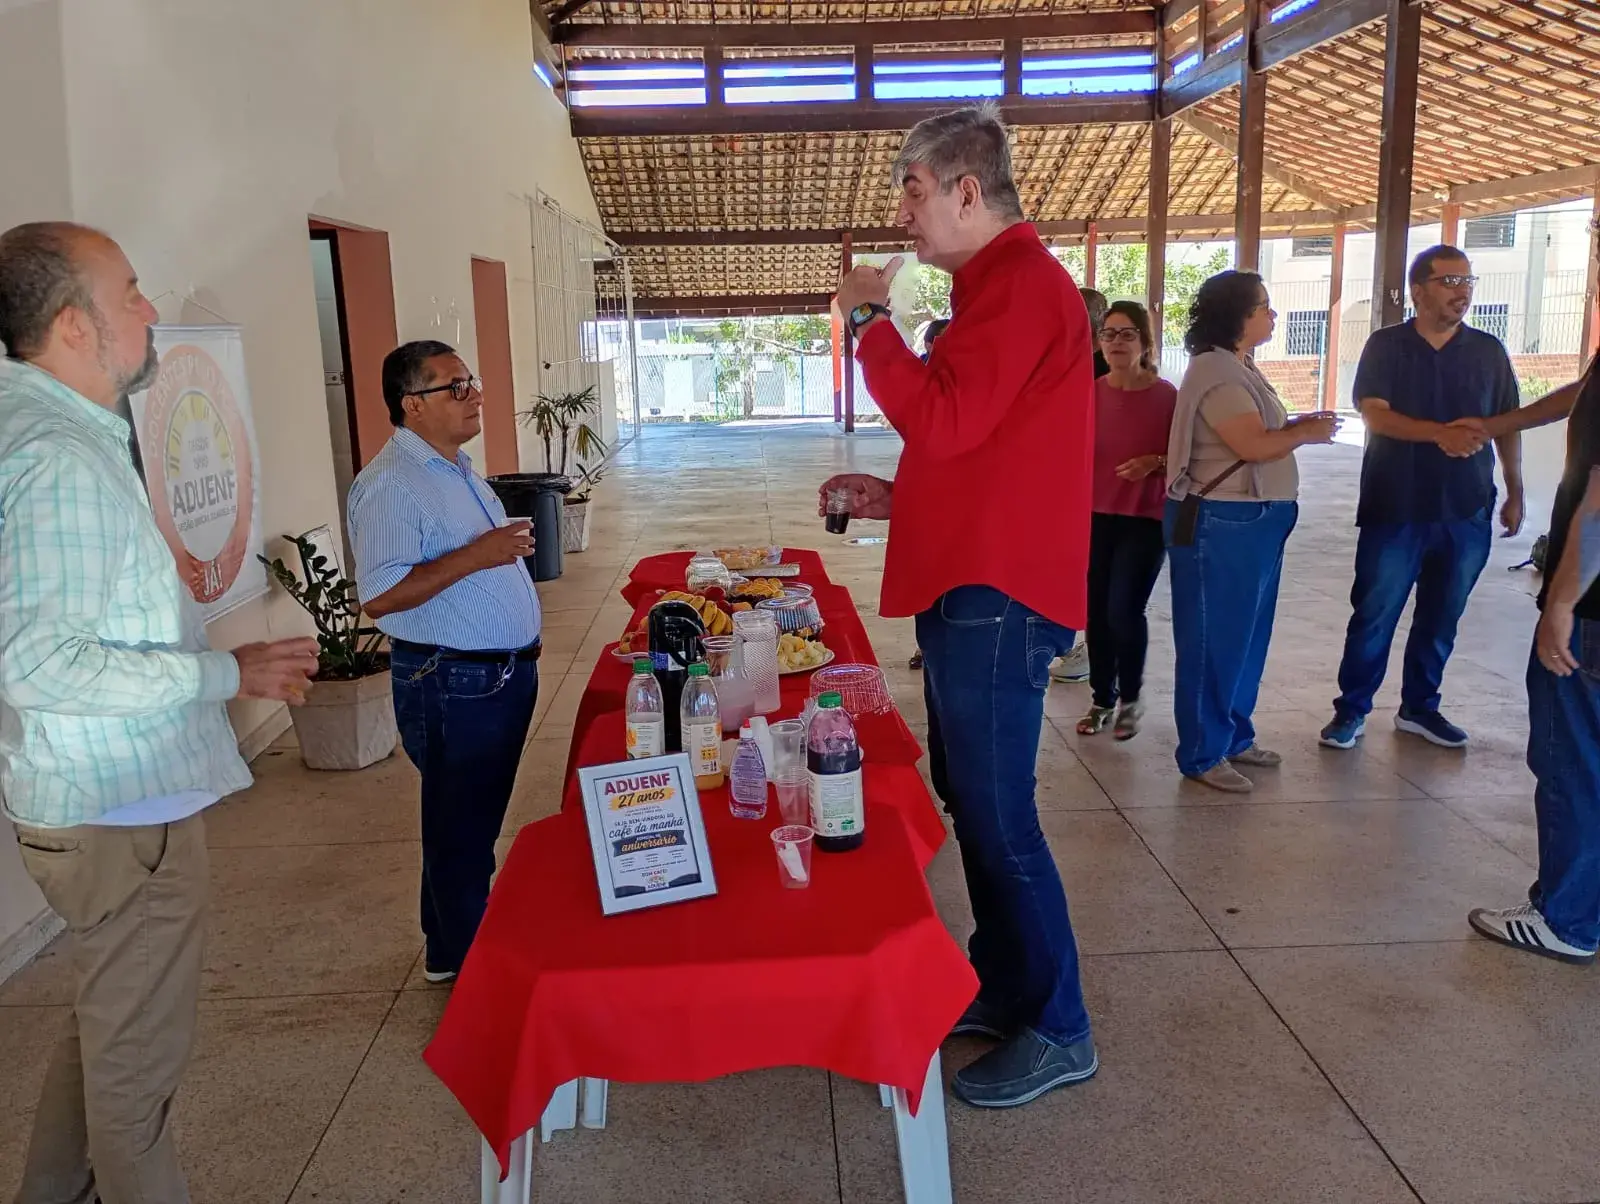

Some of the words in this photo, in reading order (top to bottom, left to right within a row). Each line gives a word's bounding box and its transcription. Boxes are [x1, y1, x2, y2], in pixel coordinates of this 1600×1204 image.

[173, 471, 235, 518] ADUENF
[204, 560, 223, 596] JÁ!
[605, 773, 670, 795] ADUENF
[618, 793, 635, 808] 27
[637, 788, 665, 803] anos
[609, 825, 632, 839] café
[634, 822, 648, 833] da
[650, 817, 684, 830] manhã
